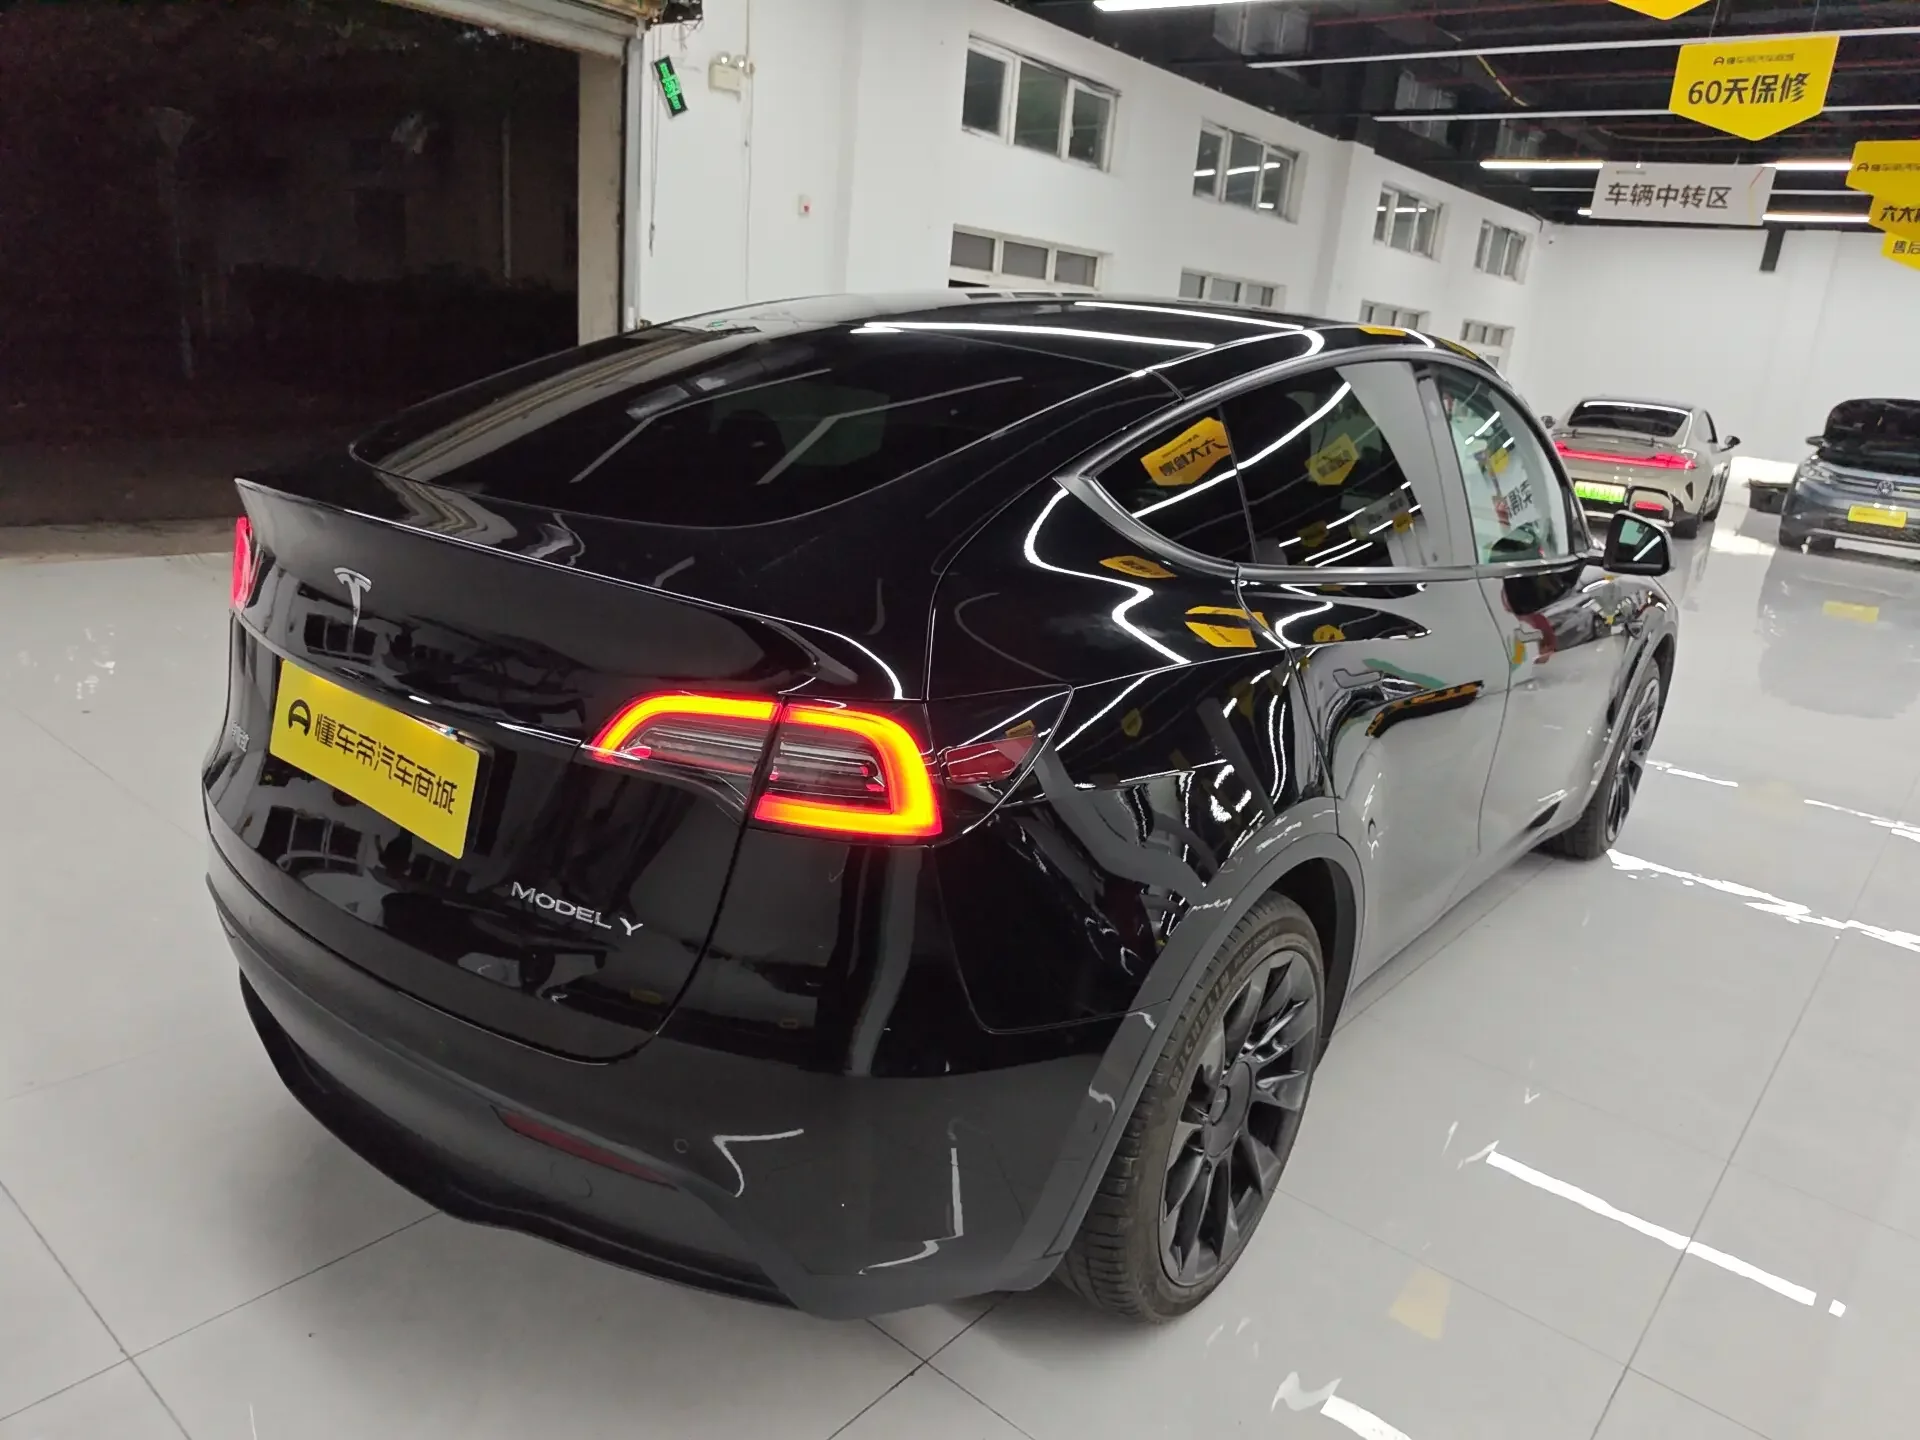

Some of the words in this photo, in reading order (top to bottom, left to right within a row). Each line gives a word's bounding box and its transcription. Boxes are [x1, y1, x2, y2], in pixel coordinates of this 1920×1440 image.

[1688, 72, 1812, 105] 60天保修
[1605, 182, 1733, 209] 车辆中转区
[1879, 205, 1920, 223] 六大
[314, 712, 459, 815] 懂车帝汽车商城
[511, 881, 613, 930] MODEL
[618, 916, 644, 937] Y
